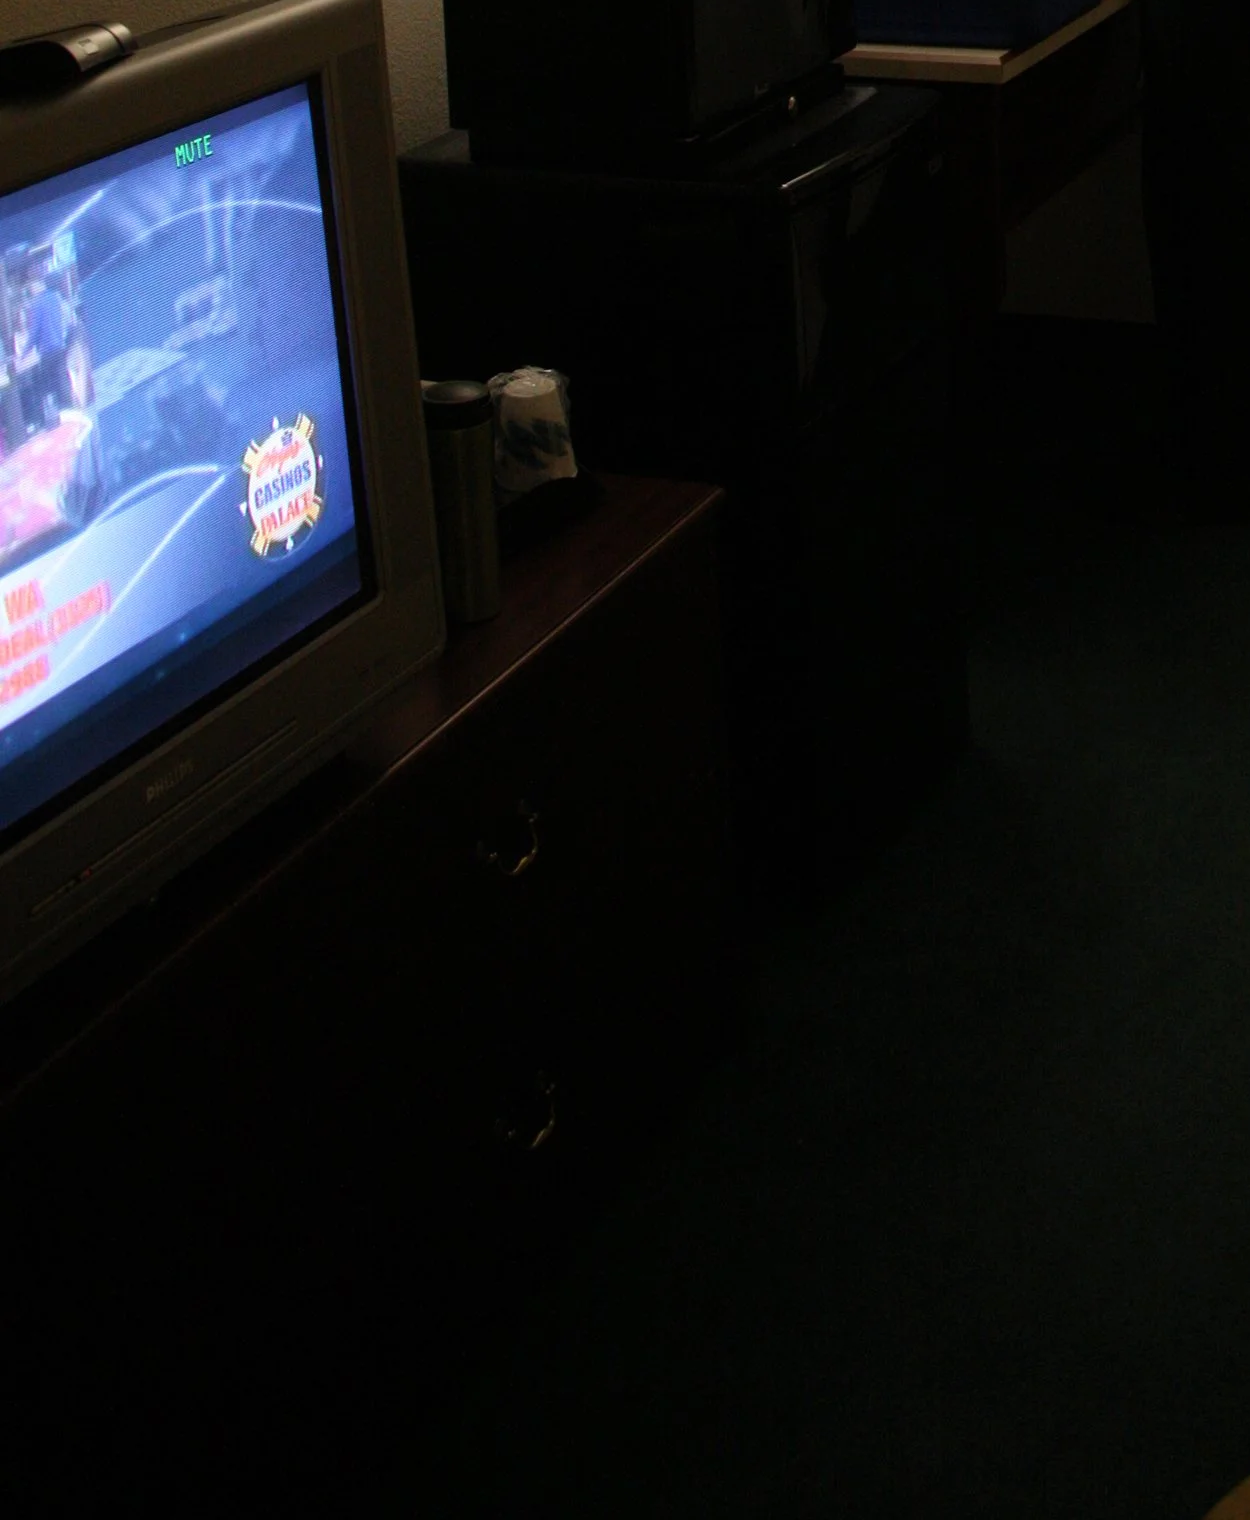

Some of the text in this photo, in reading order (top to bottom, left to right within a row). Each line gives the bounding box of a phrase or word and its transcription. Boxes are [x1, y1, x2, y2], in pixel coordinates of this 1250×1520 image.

[175, 134, 213, 167] MUTE
[254, 460, 311, 509] CASINOS
[261, 488, 313, 537] PALACE
[4, 580, 44, 625] WA
